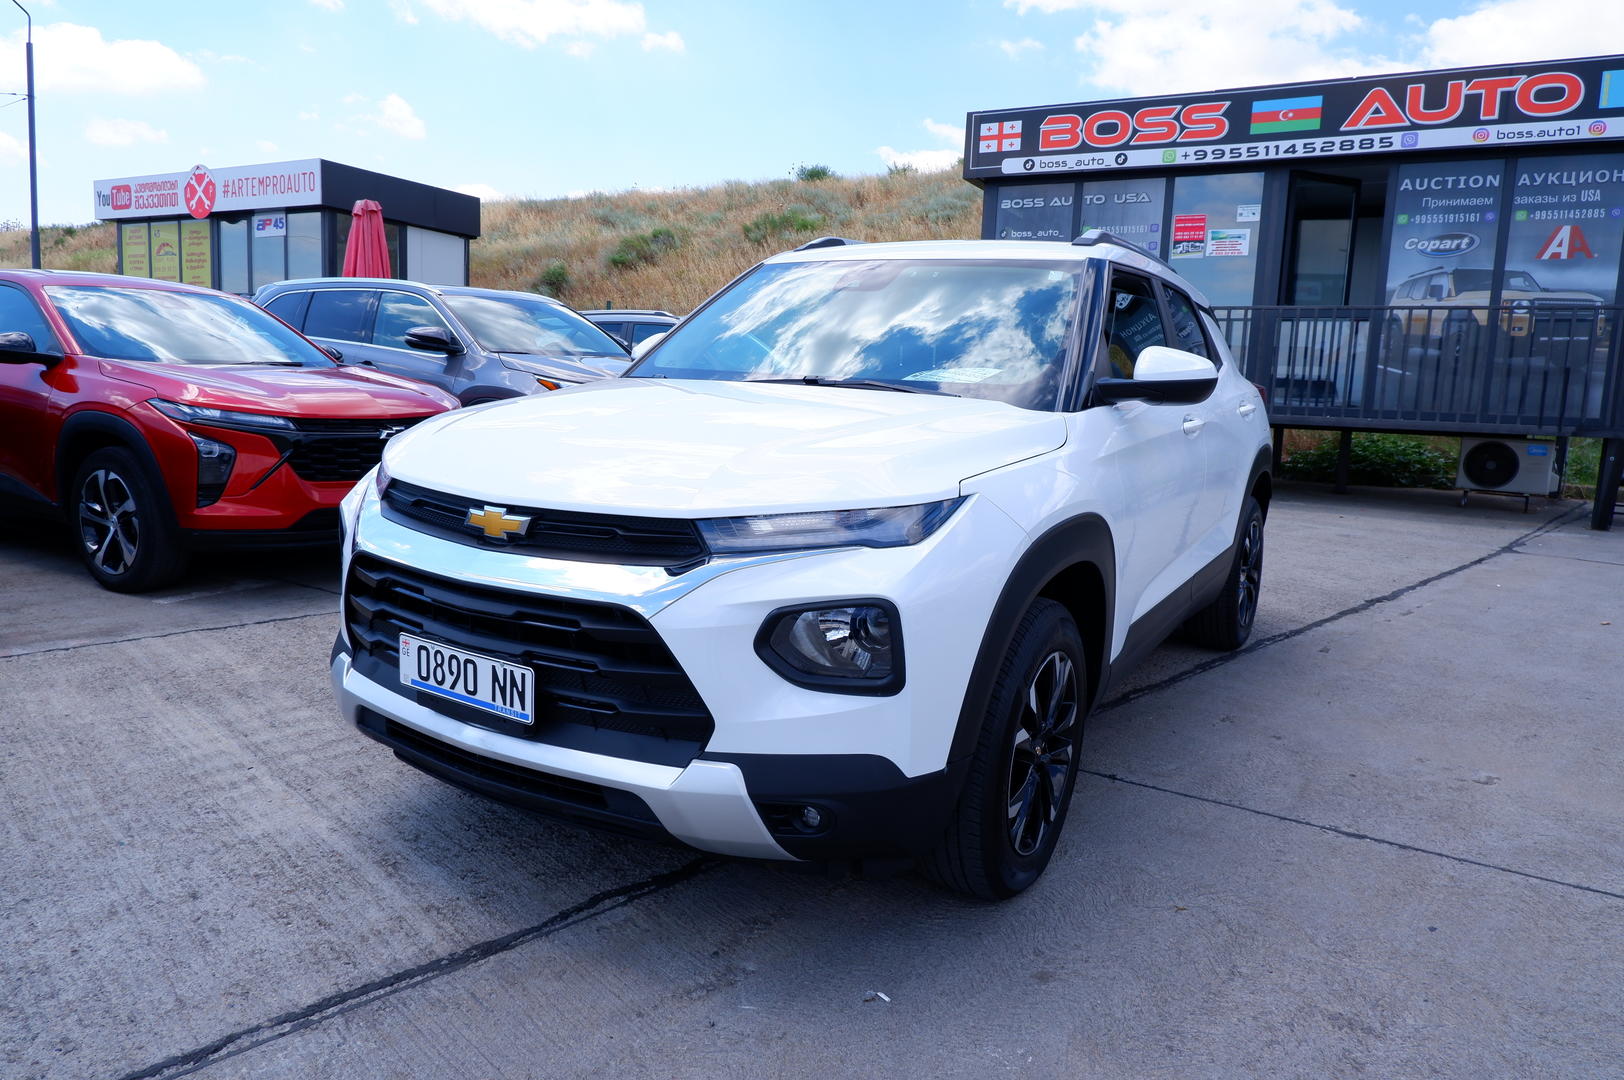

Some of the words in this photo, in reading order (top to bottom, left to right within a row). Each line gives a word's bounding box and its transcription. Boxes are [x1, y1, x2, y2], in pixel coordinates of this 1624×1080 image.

[1039, 101, 1232, 151] BOSS
[1340, 72, 1585, 131] AUTO
[1496, 125, 1581, 140] boss.auto1
[1181, 136, 1394, 161] +995511452885
[223, 171, 316, 198] #ARTEMPROAUTO
[1400, 174, 1500, 191] AUCTION
[1517, 169, 1624, 187] АУКЦИОН
[1001, 198, 1045, 209] BOSS
[1115, 193, 1151, 203] USA
[1422, 197, 1493, 208] Принимаем
[1514, 194, 1558, 205] заказы
[1563, 195, 1577, 203] из
[1581, 189, 1600, 201] USA
[273, 217, 285, 230] 45
[1404, 235, 1471, 253] Copart
[402, 647, 410, 657] GE
[417, 644, 478, 696] 0890
[492, 664, 526, 711] NN
